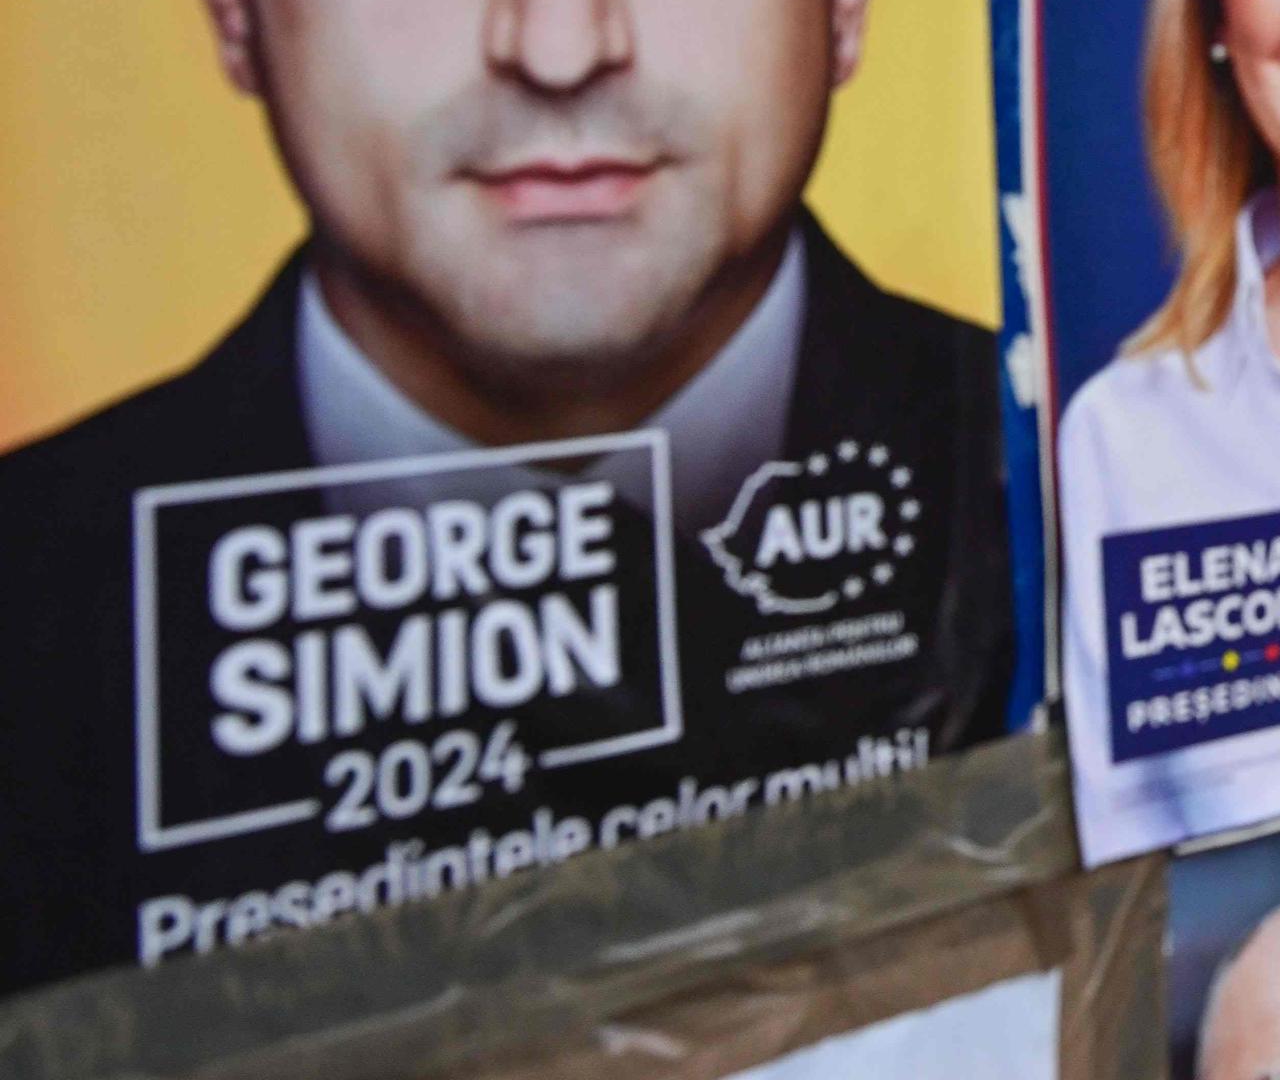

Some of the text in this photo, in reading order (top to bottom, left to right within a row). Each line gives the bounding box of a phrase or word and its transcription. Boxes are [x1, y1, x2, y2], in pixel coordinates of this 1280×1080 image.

[209, 480, 617, 631] GEORGE
[755, 491, 888, 569] AUR
[210, 583, 621, 757] SIMION
[323, 719, 532, 833] 2024
